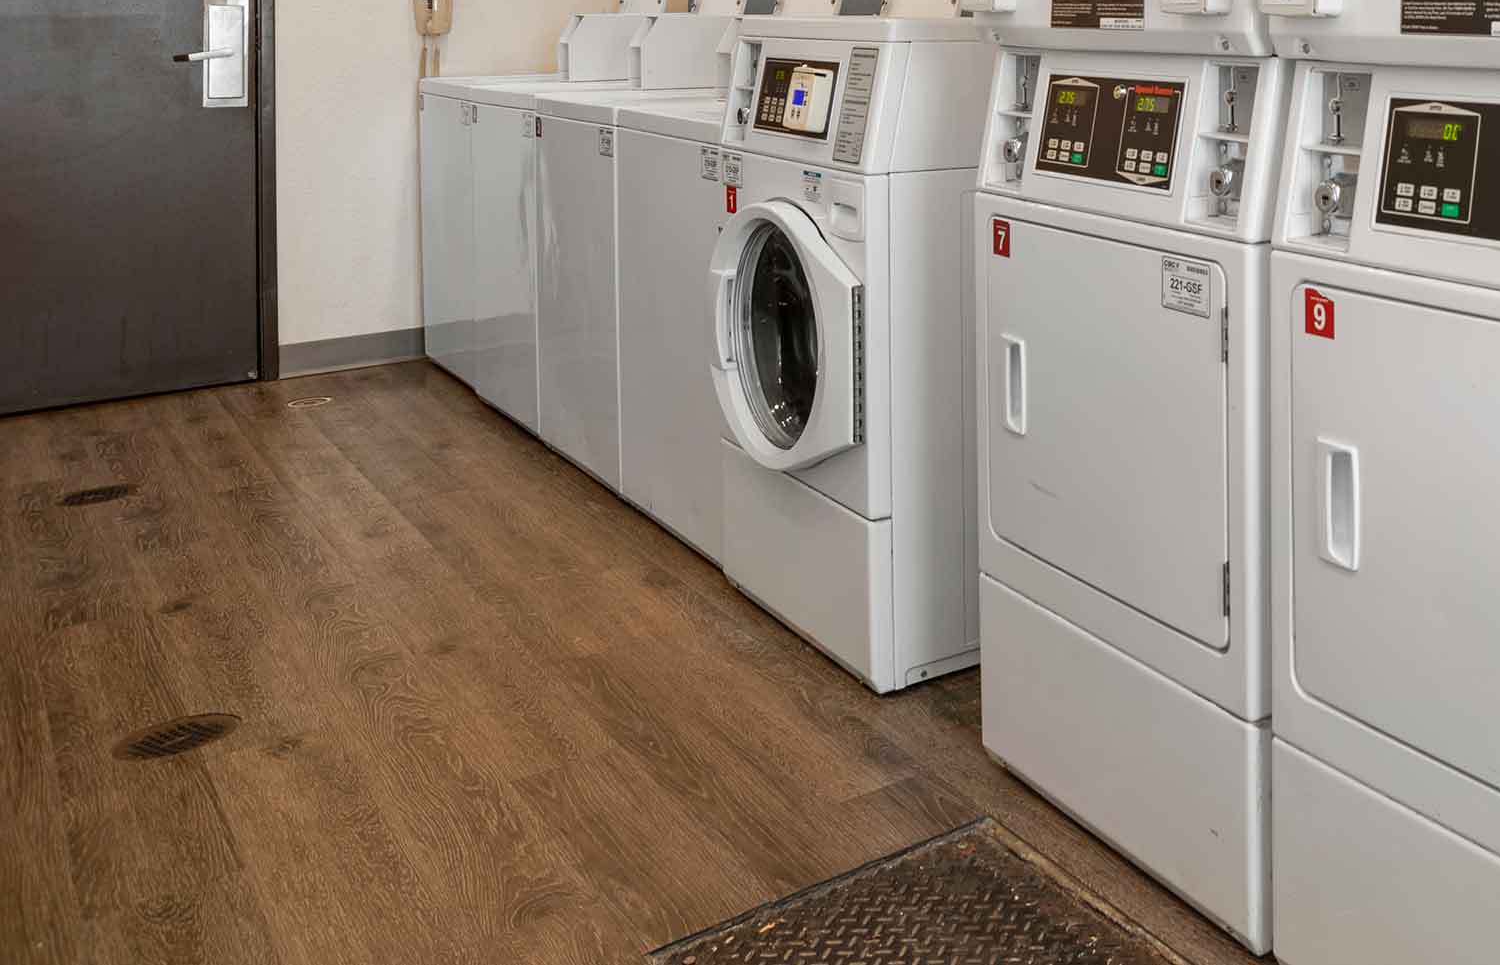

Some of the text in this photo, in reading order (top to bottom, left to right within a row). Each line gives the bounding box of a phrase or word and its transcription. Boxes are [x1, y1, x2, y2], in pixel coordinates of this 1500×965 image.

[998, 230, 1006, 251] 7
[1170, 277, 1203, 295] 221-GSF
[1313, 303, 1326, 331] 9
